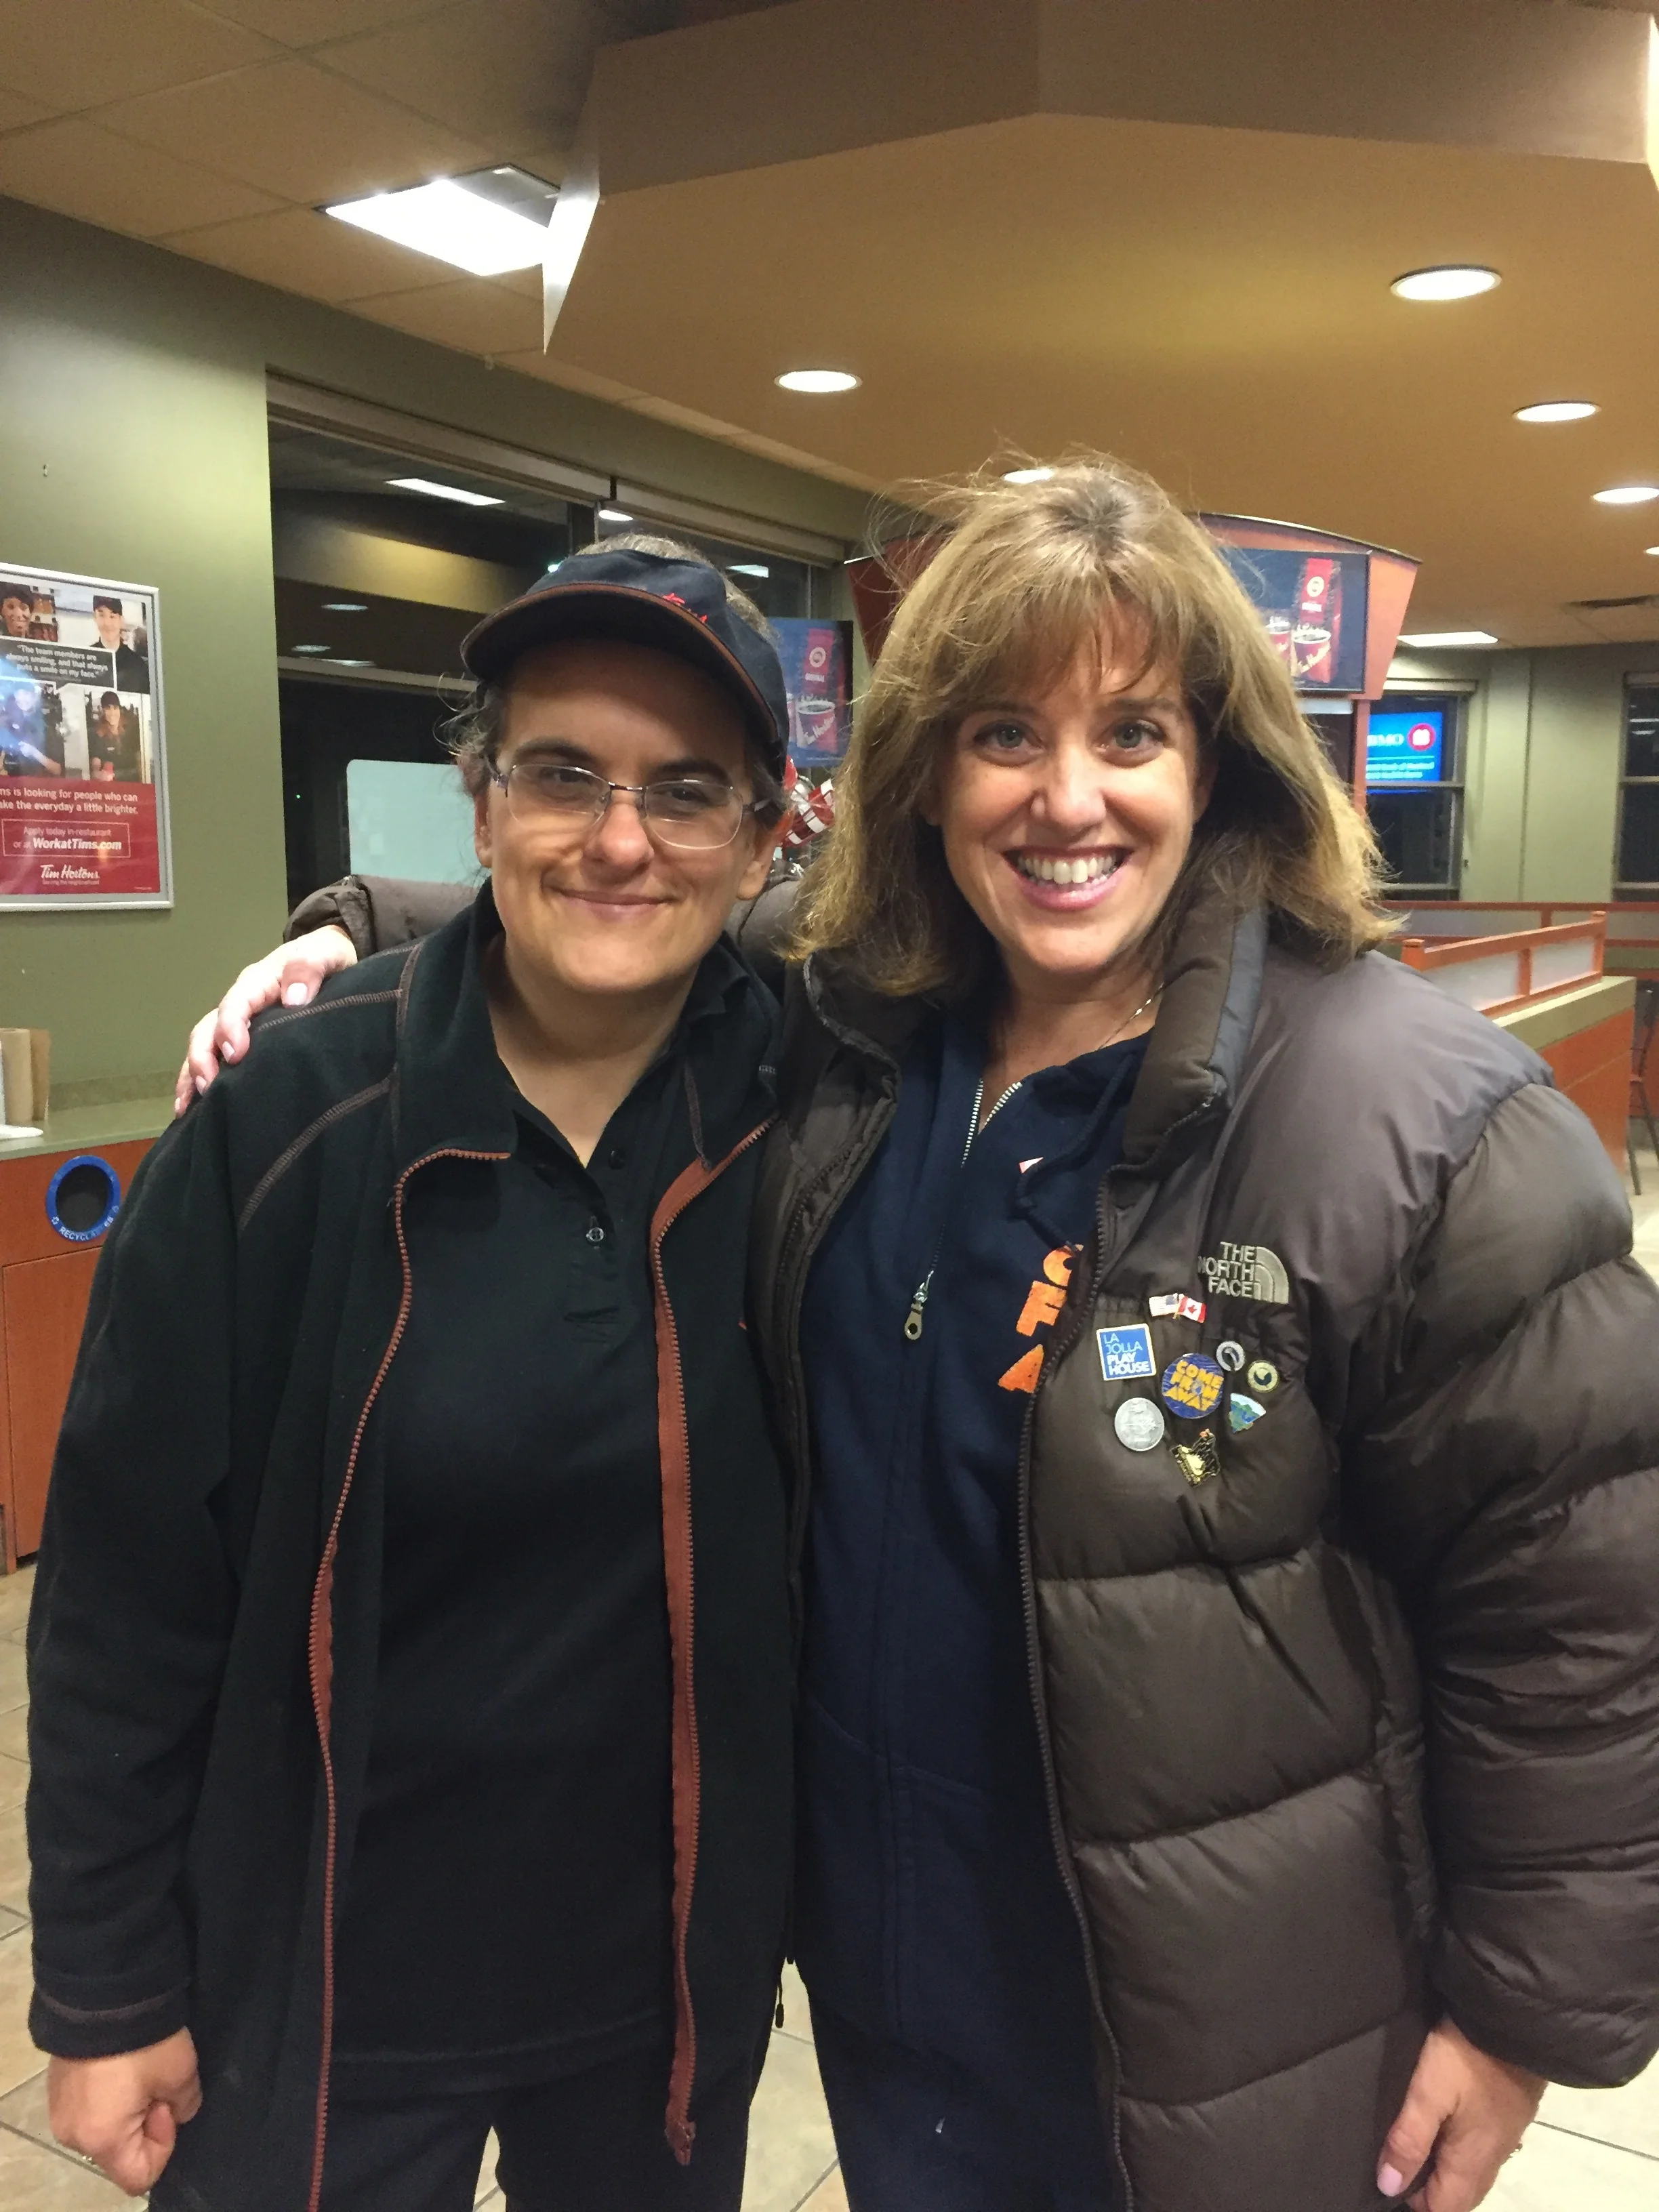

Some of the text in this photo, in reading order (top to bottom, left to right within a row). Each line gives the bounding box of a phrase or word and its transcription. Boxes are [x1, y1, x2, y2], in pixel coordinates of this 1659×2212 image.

[14, 788, 21, 797] is
[24, 787, 57, 800] looking
[59, 789, 71, 798] for
[73, 792, 102, 801] people
[104, 792, 121, 801] who
[123, 794, 138, 802] can
[16, 800, 32, 810] the
[34, 802, 75, 813] everyday
[83, 802, 102, 813] little
[104, 804, 138, 815] brighter.
[33, 837, 122, 851] WorkatTims.com
[40, 864, 60, 879] Tim
[1220, 1241, 1256, 1263] THE
[1197, 1255, 1255, 1282] NORTH
[1208, 1275, 1254, 1298] FACE
[1103, 1332, 1120, 1345] LA
[1105, 1340, 1143, 1355] JOLLA
[1106, 1351, 1136, 1366] PLAY
[1108, 1360, 1151, 1376] HOUSE
[1176, 1359, 1225, 1389] COME
